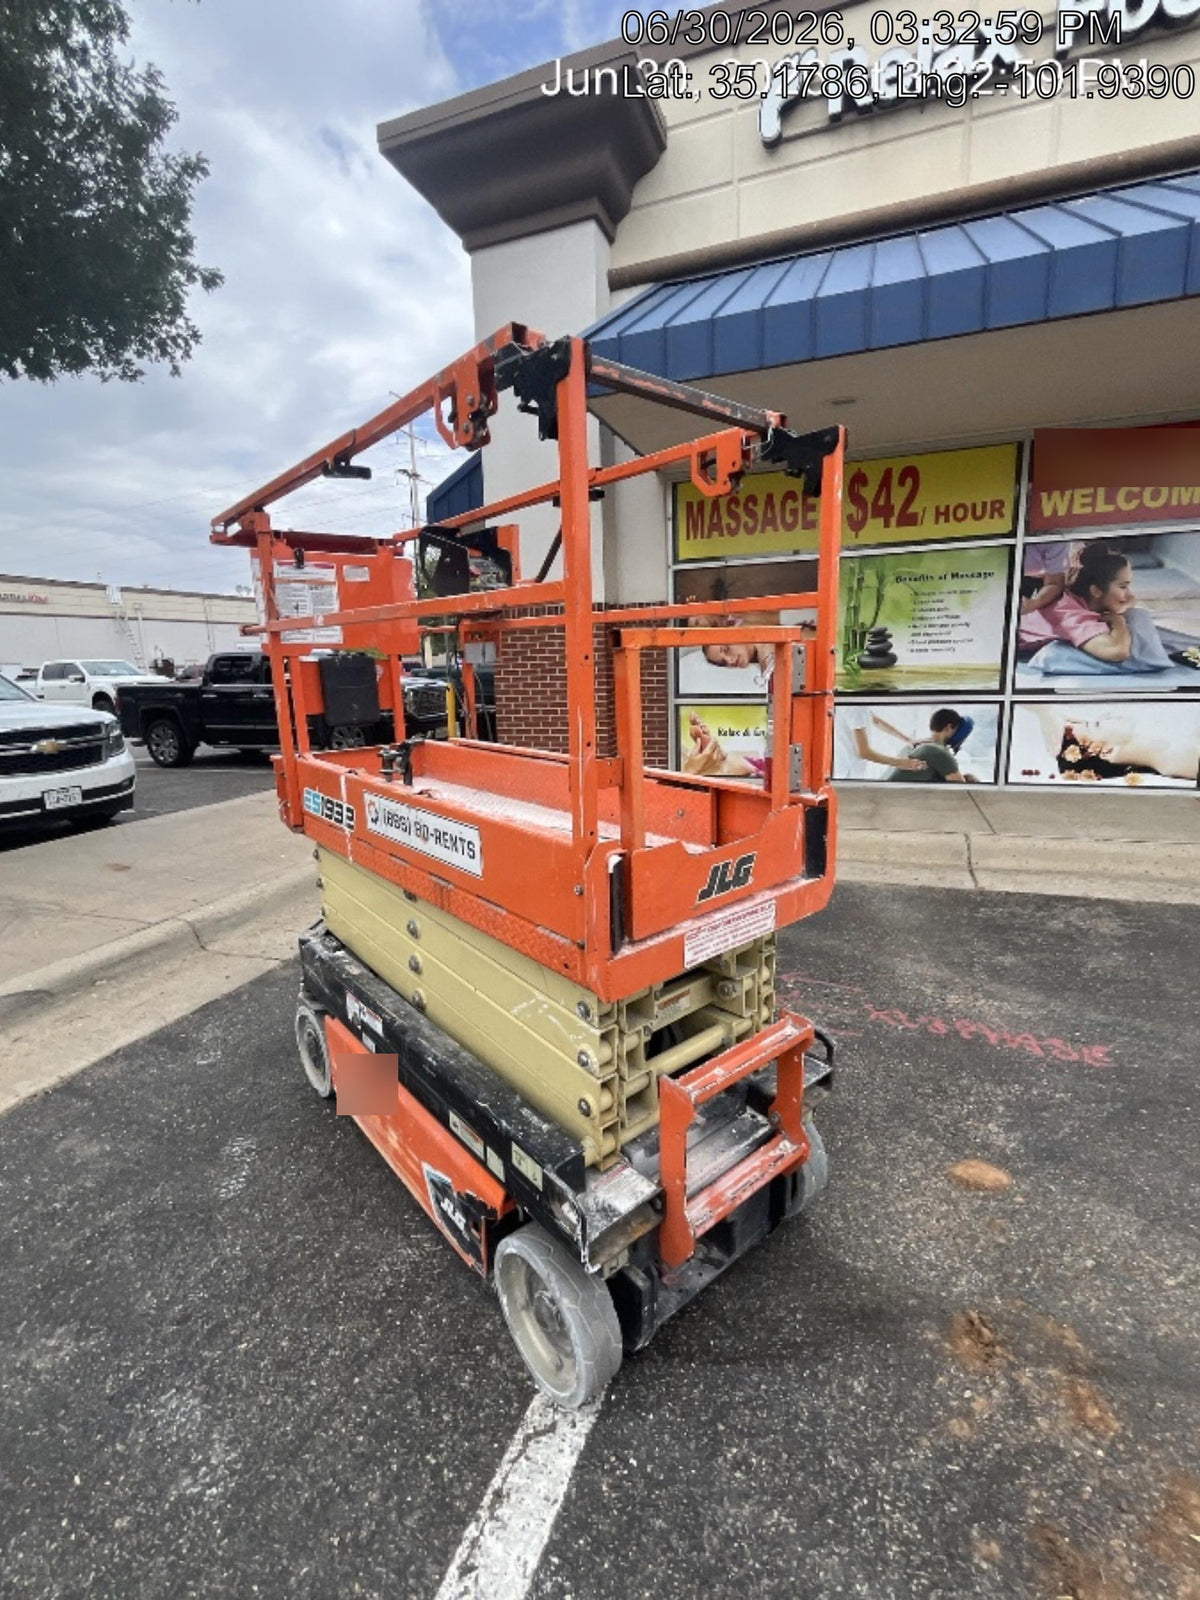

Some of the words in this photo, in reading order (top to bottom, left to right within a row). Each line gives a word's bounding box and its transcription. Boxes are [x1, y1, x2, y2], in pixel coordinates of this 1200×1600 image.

[686, 490, 817, 540] MASSAGE
[934, 499, 1005, 525] HOUR
[697, 852, 758, 903] JLG
